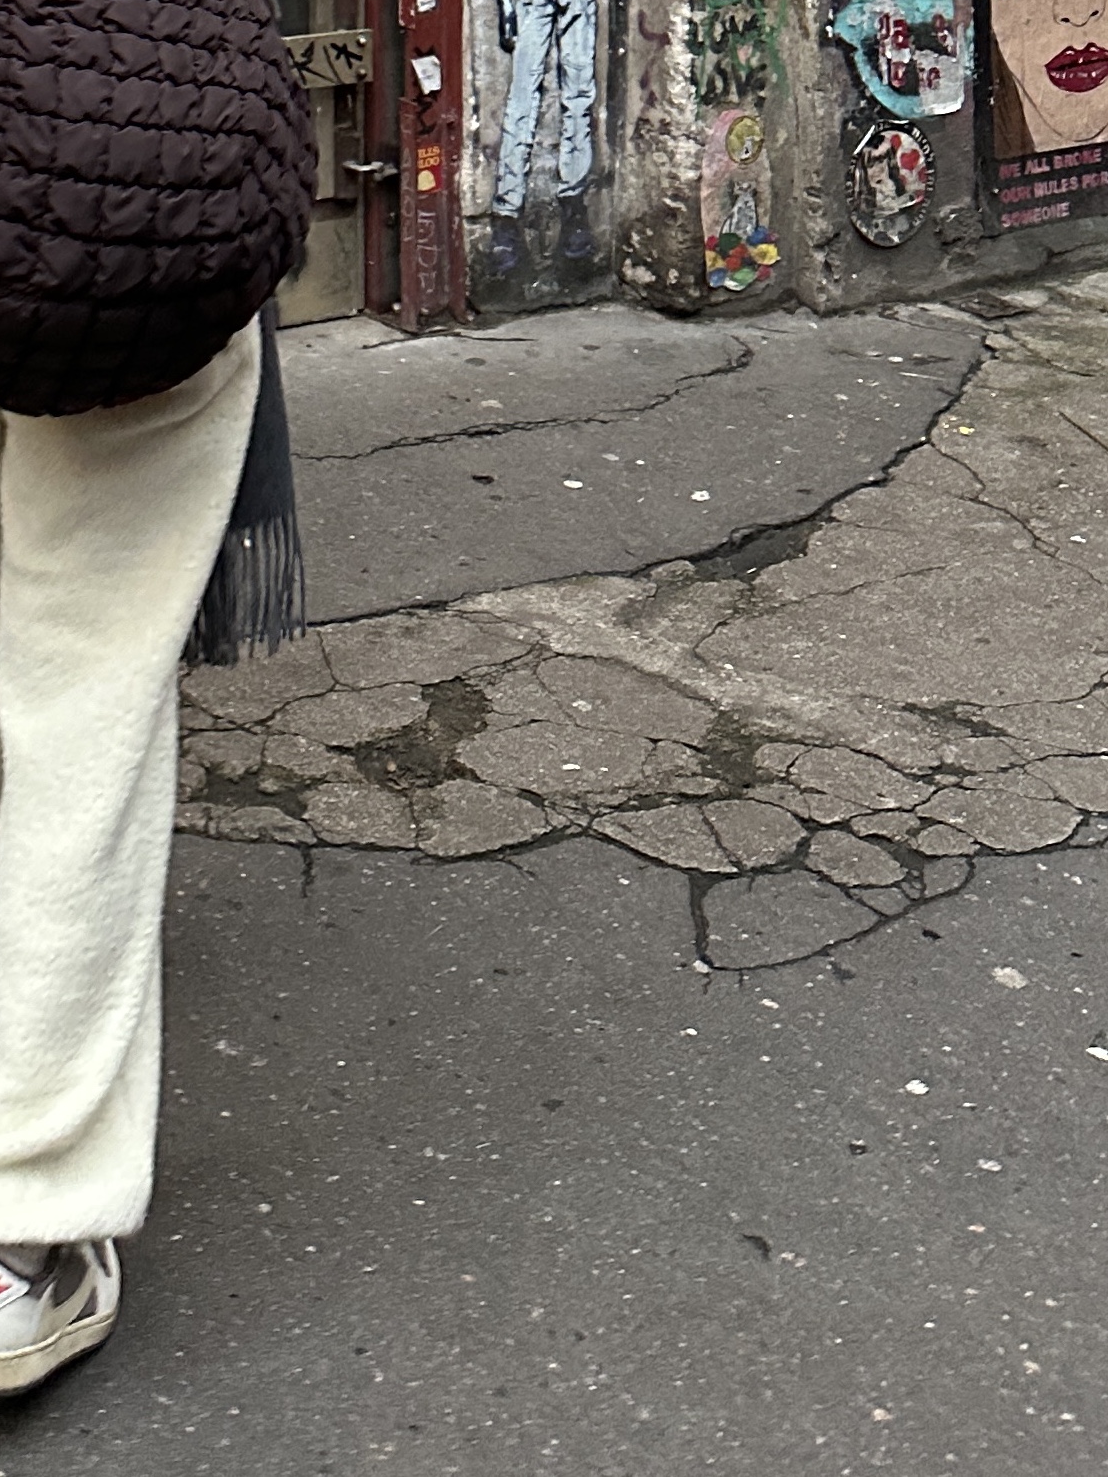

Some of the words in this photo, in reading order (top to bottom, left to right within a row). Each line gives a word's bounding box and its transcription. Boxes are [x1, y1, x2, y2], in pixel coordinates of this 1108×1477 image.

[1024, 157, 1051, 175] ALL
[1052, 147, 1103, 170] BROKE
[1033, 176, 1079, 199] RULES
